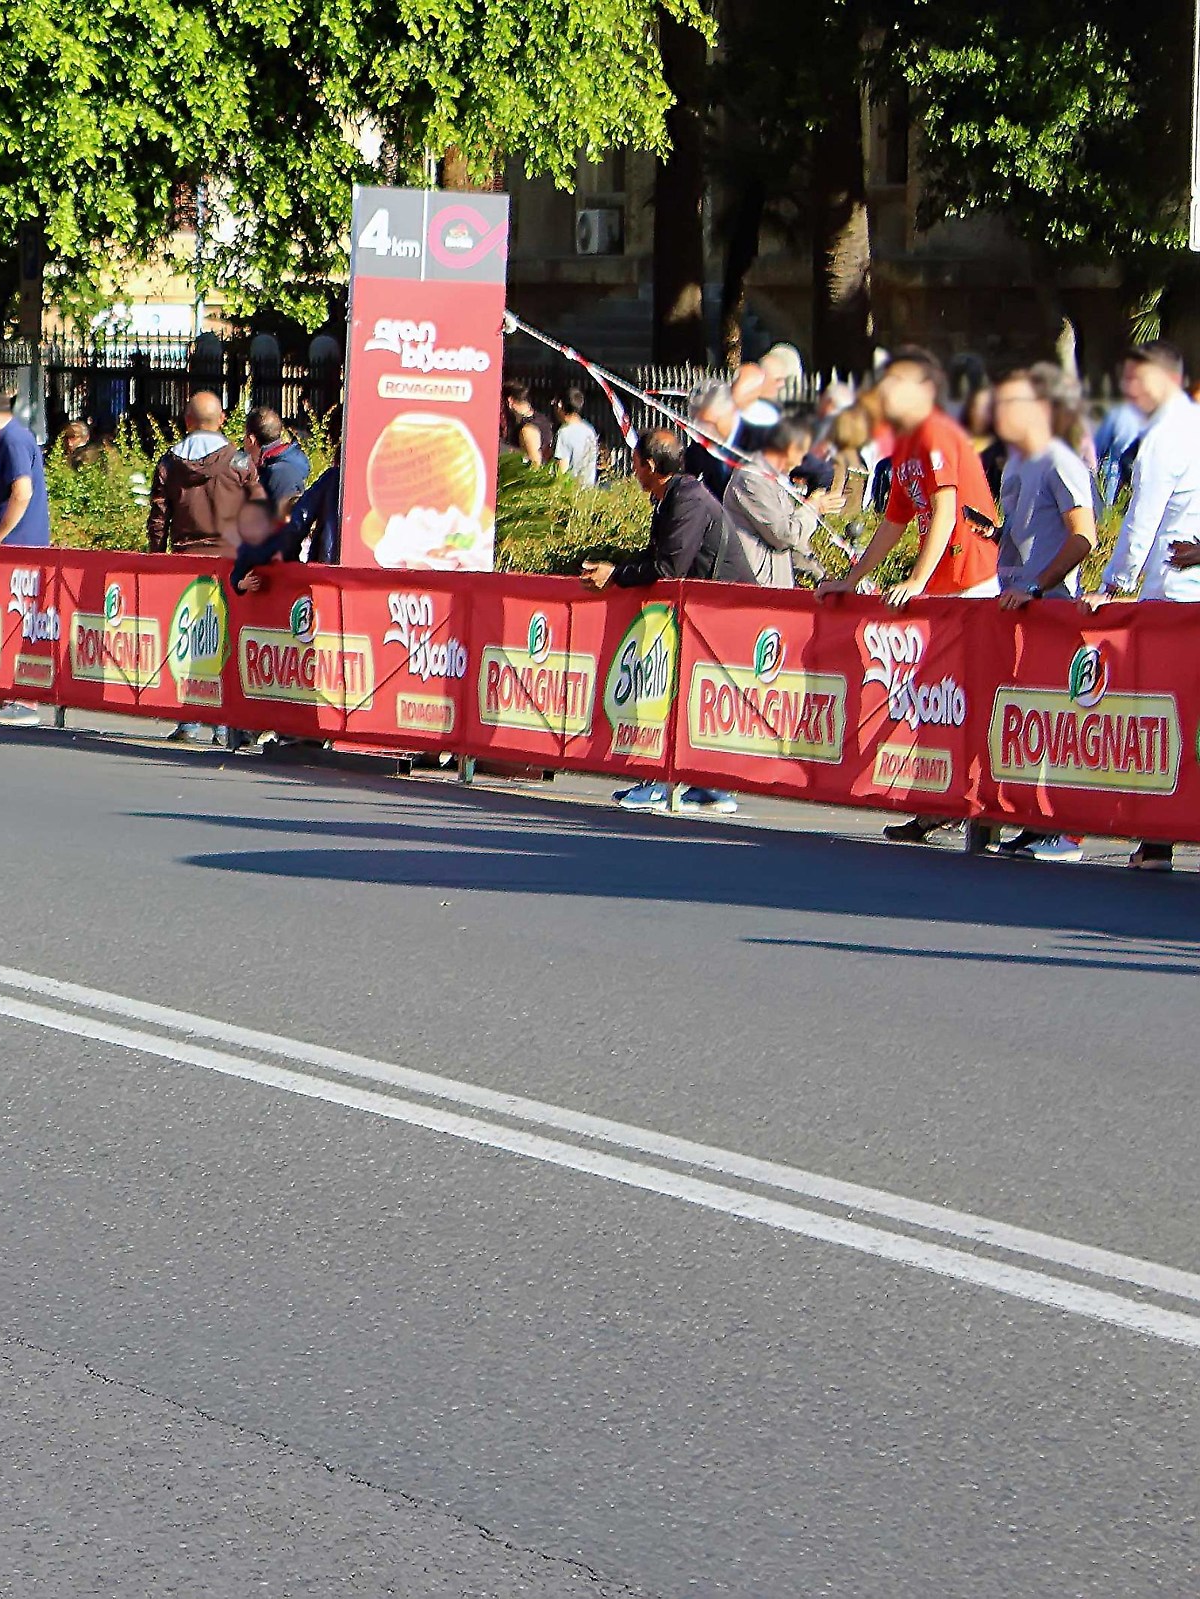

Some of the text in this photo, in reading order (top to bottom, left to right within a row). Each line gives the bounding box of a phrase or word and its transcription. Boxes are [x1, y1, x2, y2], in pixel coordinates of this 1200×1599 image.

[364, 318, 436, 355] gran
[385, 381, 465, 396] ROVAGNATI
[177, 604, 219, 661] Snello
[384, 592, 433, 648] gran
[76, 624, 156, 673] ROVAGNATI
[245, 640, 367, 694] ROVAGNATI
[615, 636, 670, 707] Snello
[863, 620, 922, 690] gran
[486, 660, 588, 720] ROVAGNATI
[698, 678, 837, 745] ROVAGNATI
[879, 751, 947, 783] ROVAGNATI
[1000, 703, 1170, 775] ROVAGNATI
